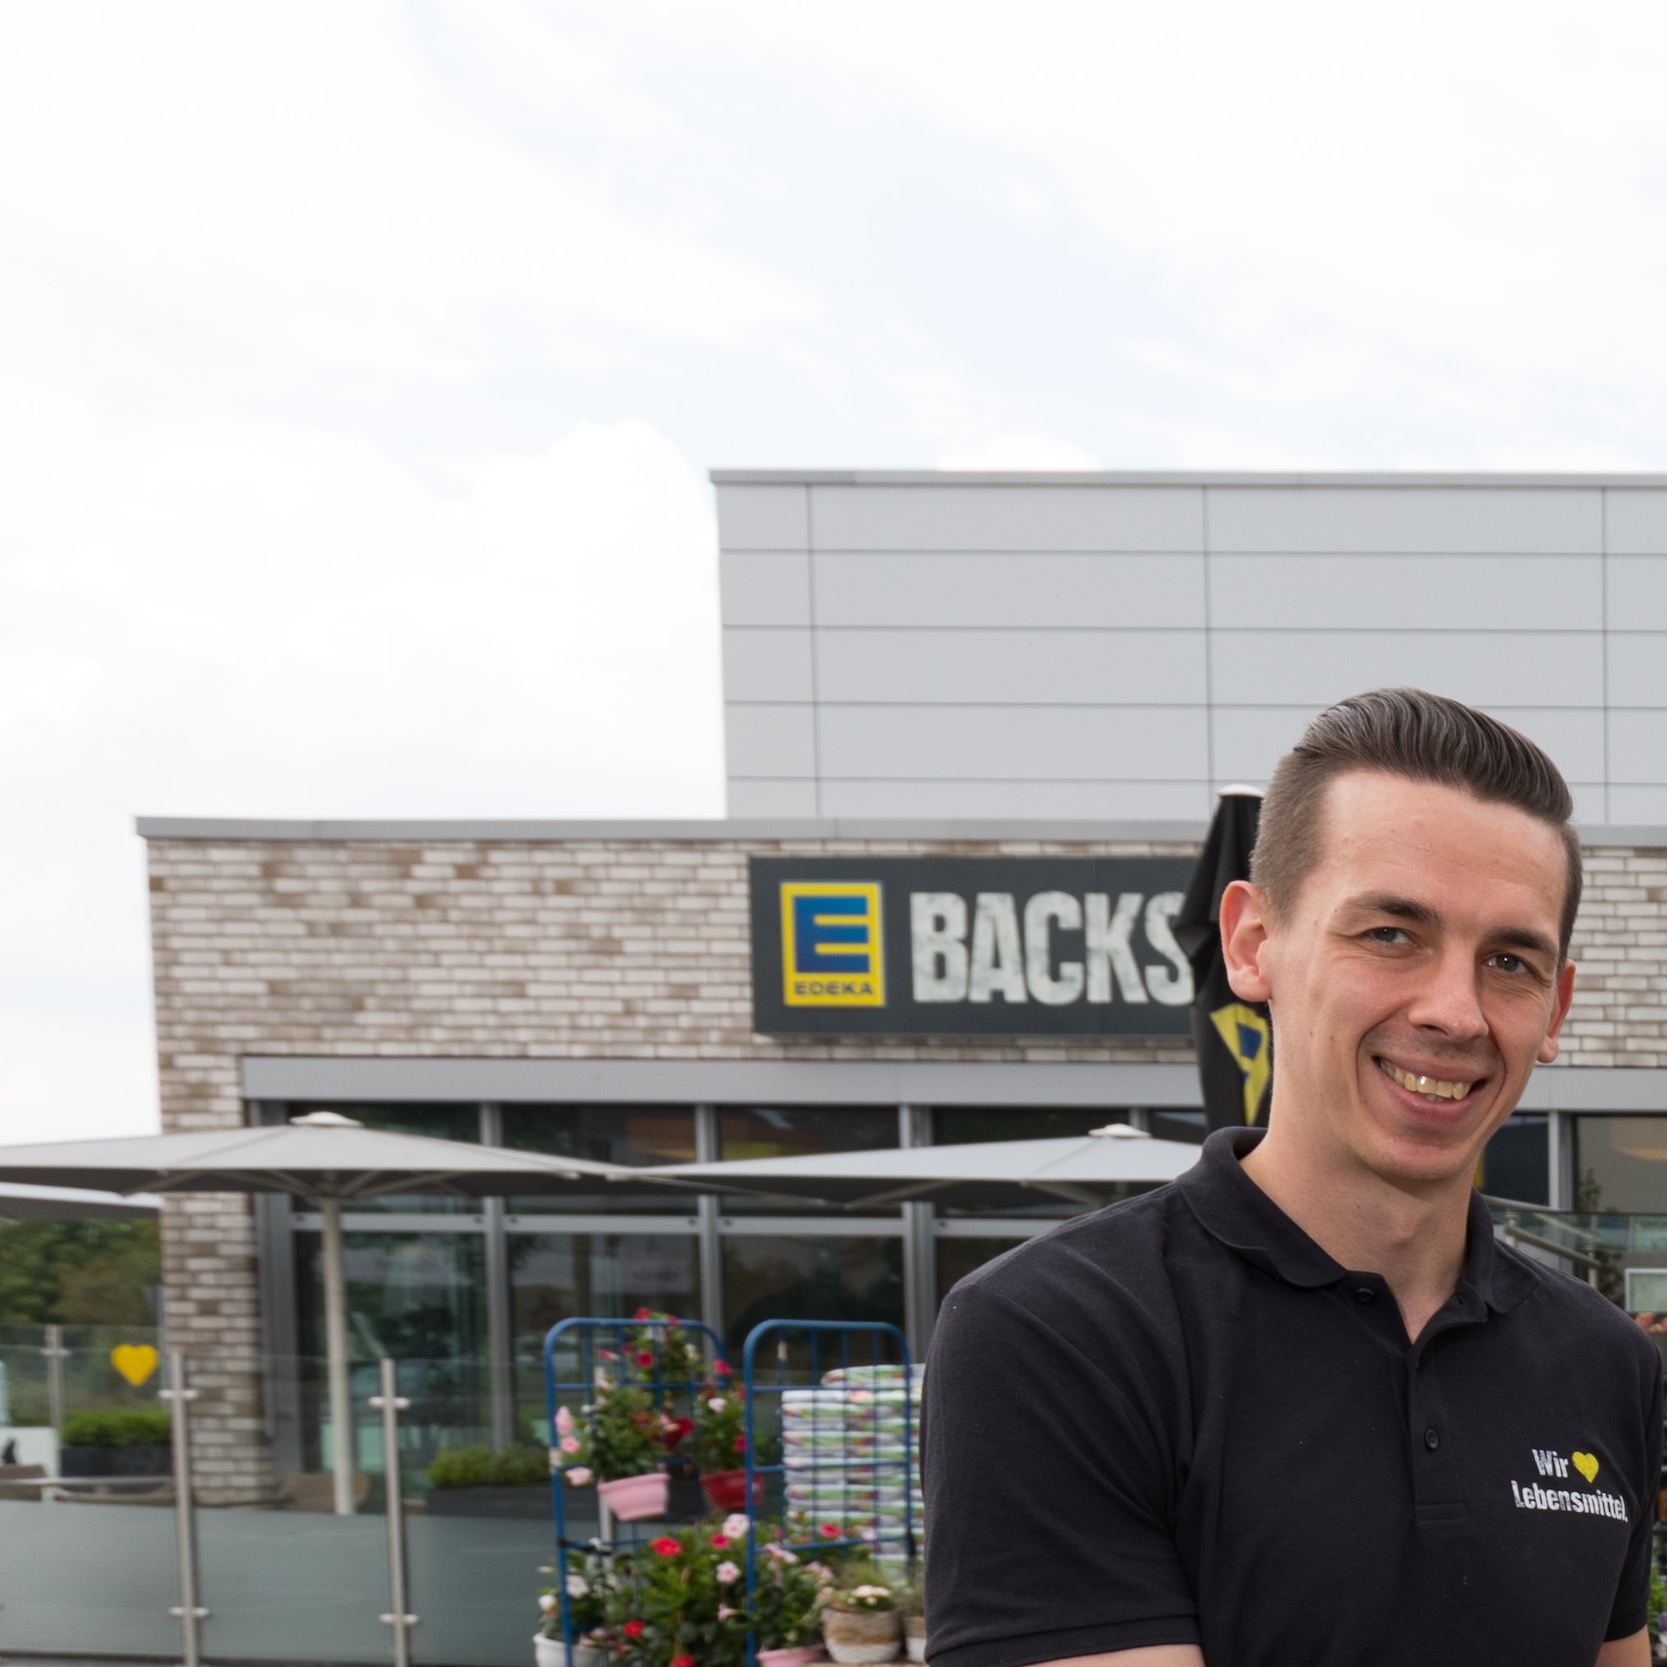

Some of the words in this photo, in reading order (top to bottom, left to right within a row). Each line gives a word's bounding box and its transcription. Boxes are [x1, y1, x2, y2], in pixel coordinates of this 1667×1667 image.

[794, 981, 874, 996] EDEKA
[1532, 1449, 1569, 1478] Wir
[1511, 1480, 1628, 1522] Lebensmittel.
